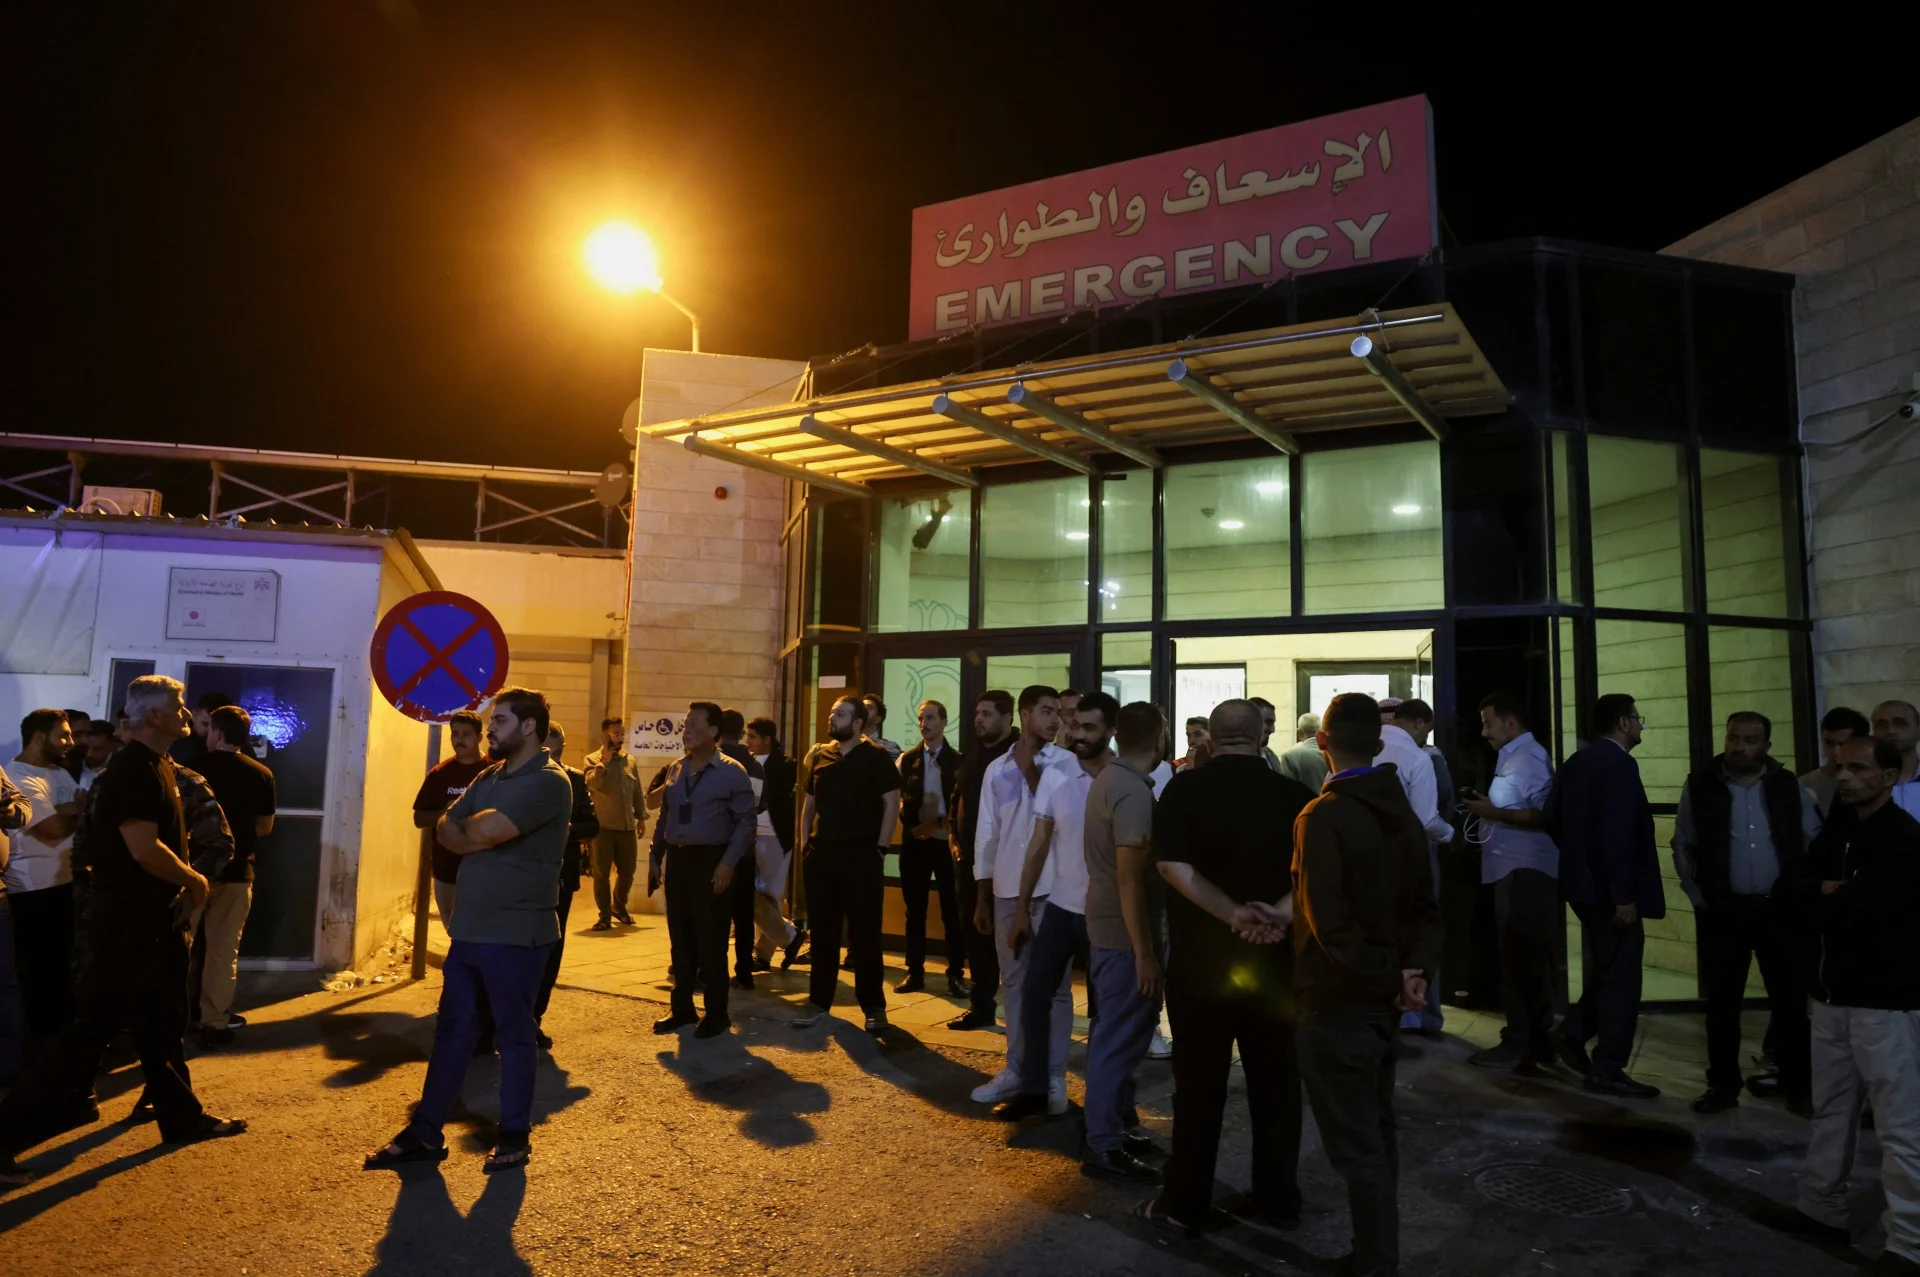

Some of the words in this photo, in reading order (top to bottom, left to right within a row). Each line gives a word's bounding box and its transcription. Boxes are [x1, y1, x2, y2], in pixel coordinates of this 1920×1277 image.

[1162, 127, 1393, 216] الإسعاف
[934, 184, 1147, 268] والطوارئ
[935, 211, 1391, 332] EMERGENCY
[447, 786, 466, 795] Ree
